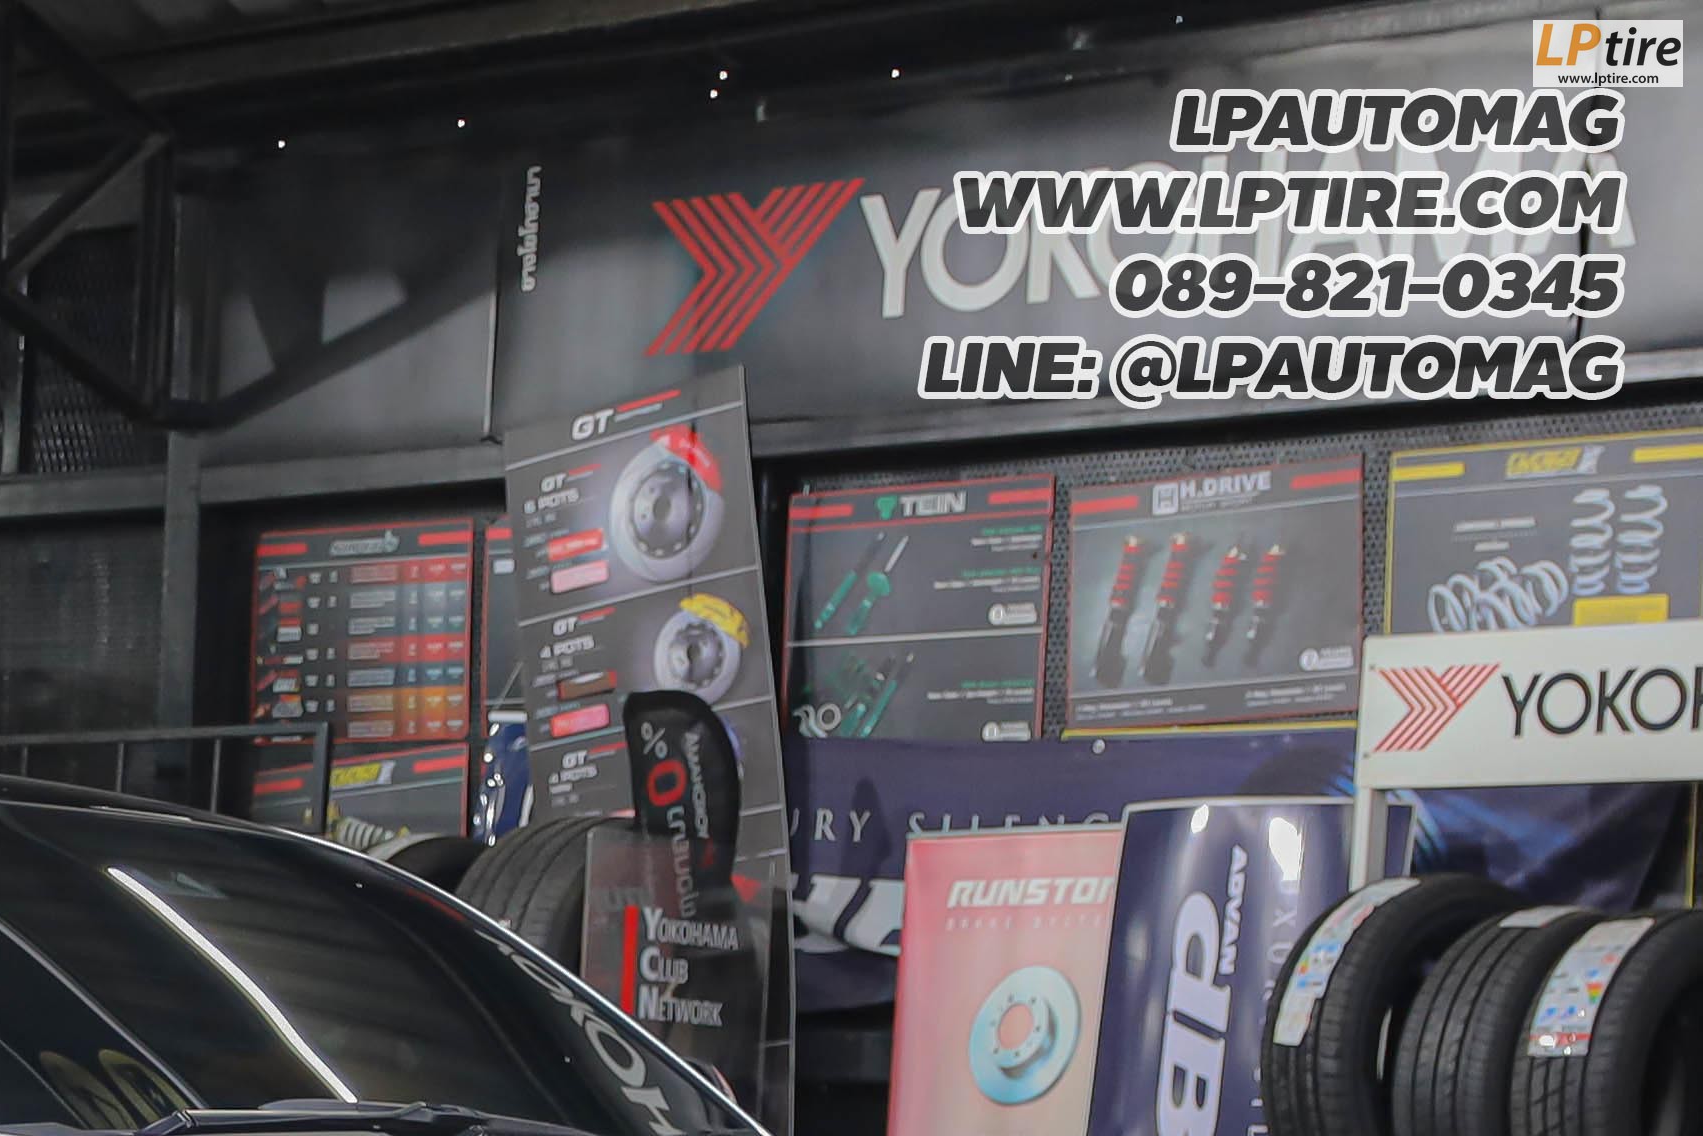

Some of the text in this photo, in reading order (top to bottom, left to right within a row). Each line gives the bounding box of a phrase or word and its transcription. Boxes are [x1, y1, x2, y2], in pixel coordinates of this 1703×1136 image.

[572, 408, 614, 440] GT
[900, 491, 967, 516] TEIN
[643, 906, 740, 950] YOKOHAMA
[1219, 844, 1248, 976] ADVAN
[640, 947, 689, 984] CLUB
[638, 984, 724, 1027] NETWORK
